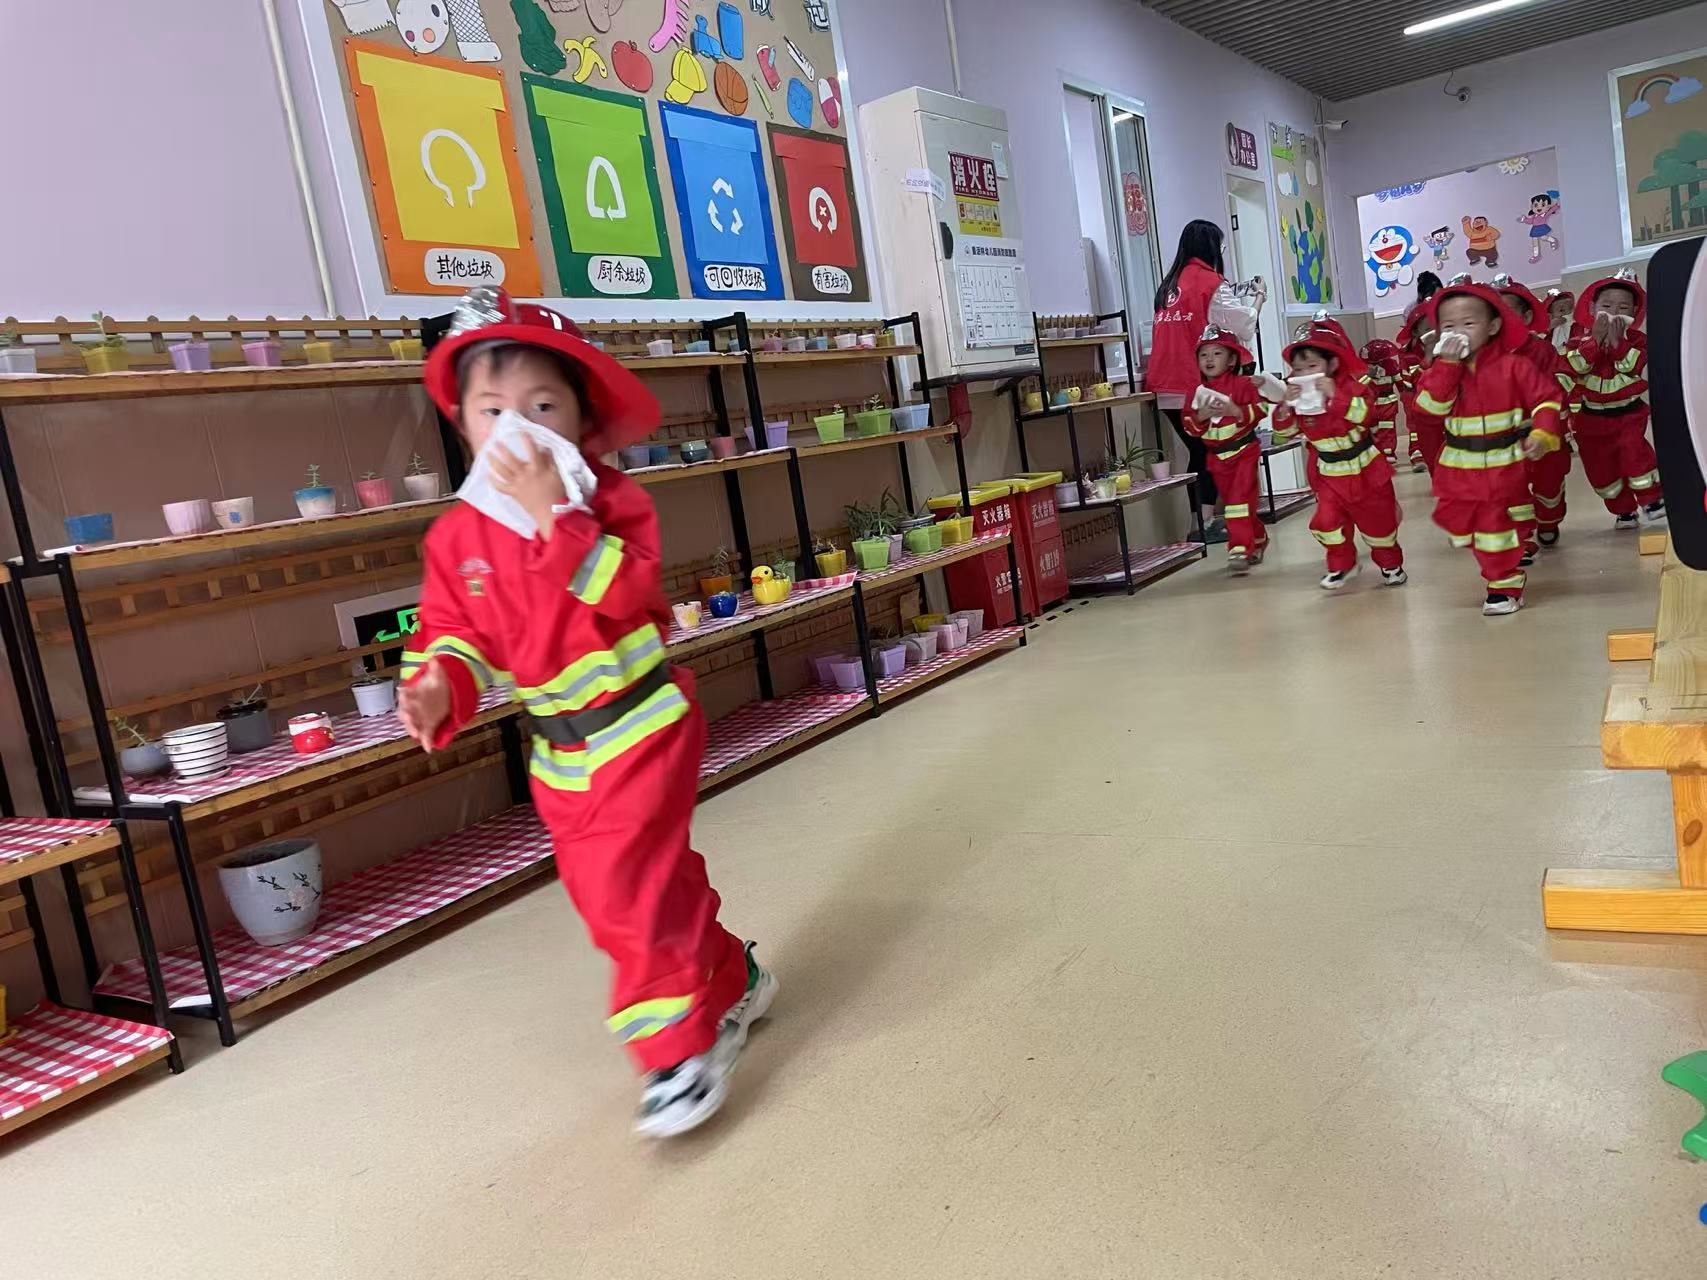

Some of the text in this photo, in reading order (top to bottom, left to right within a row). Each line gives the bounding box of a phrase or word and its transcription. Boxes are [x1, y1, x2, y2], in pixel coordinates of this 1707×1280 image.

[951, 155, 997, 191] 消火栓
[437, 254, 495, 279] 其他垃圾
[598, 260, 645, 285] 厨余垃圾
[707, 267, 763, 288] 可回收垃圾
[815, 268, 849, 291] 有害垃圾
[982, 504, 1011, 525] 灭火器箱
